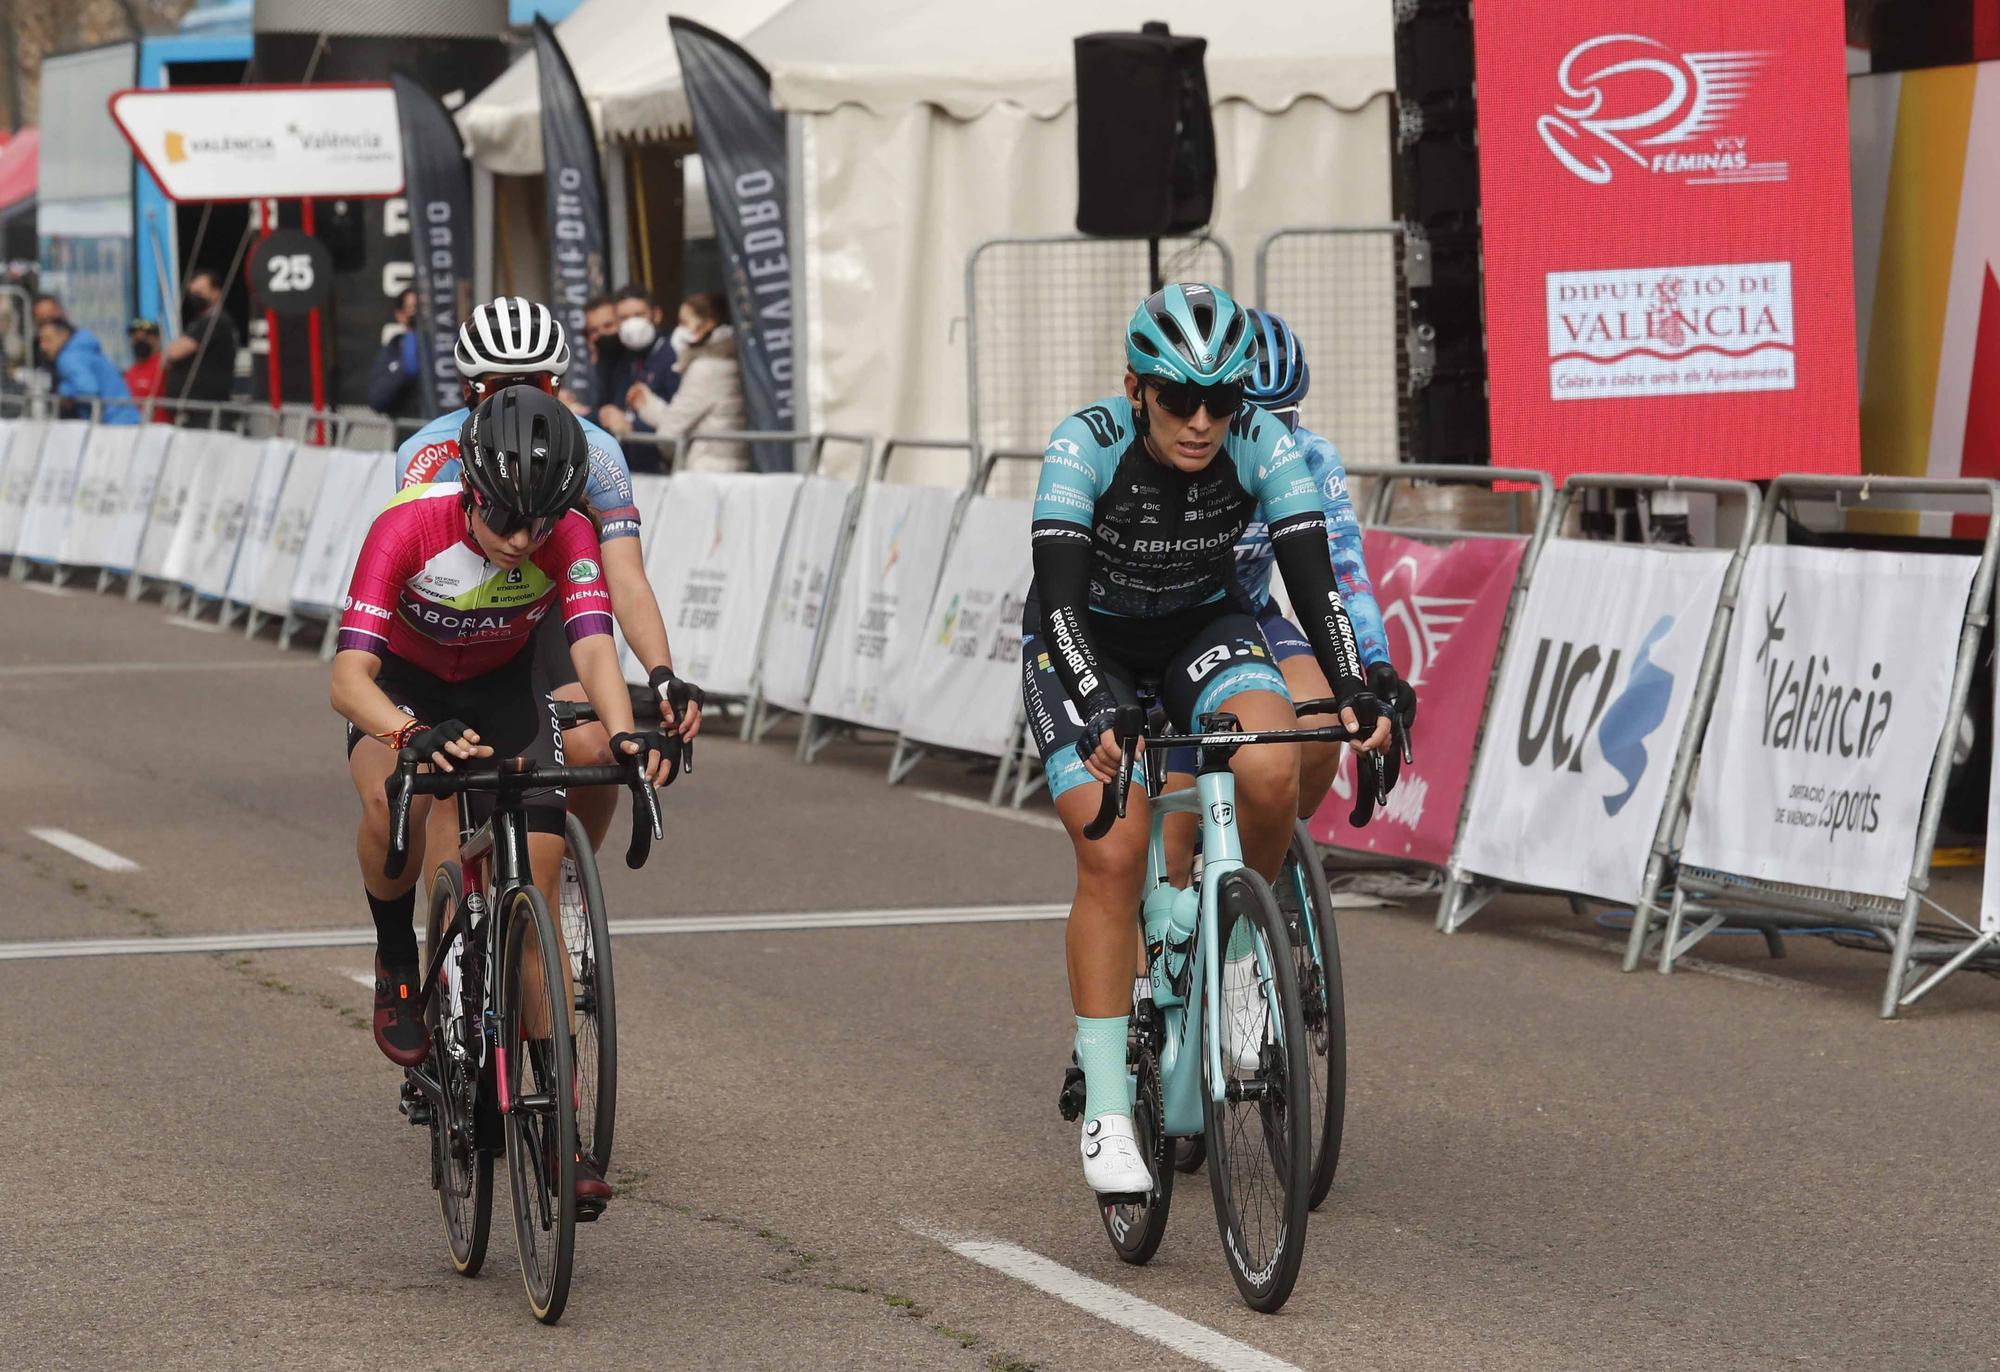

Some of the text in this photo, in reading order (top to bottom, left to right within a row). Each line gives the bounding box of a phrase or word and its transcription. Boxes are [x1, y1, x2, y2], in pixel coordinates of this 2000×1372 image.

[267, 254, 315, 292] 25
[1739, 275, 1778, 294] DE
[1132, 519, 1244, 553] RBHGlobal
[412, 584, 456, 602] ORBEA
[1049, 608, 1085, 675] RBHGlobal
[1063, 605, 1097, 666] CONSULTORES
[1324, 615, 1349, 677] CONSULTORES
[1336, 613, 1363, 681] RBHGlobal
[1762, 654, 1893, 760] València
